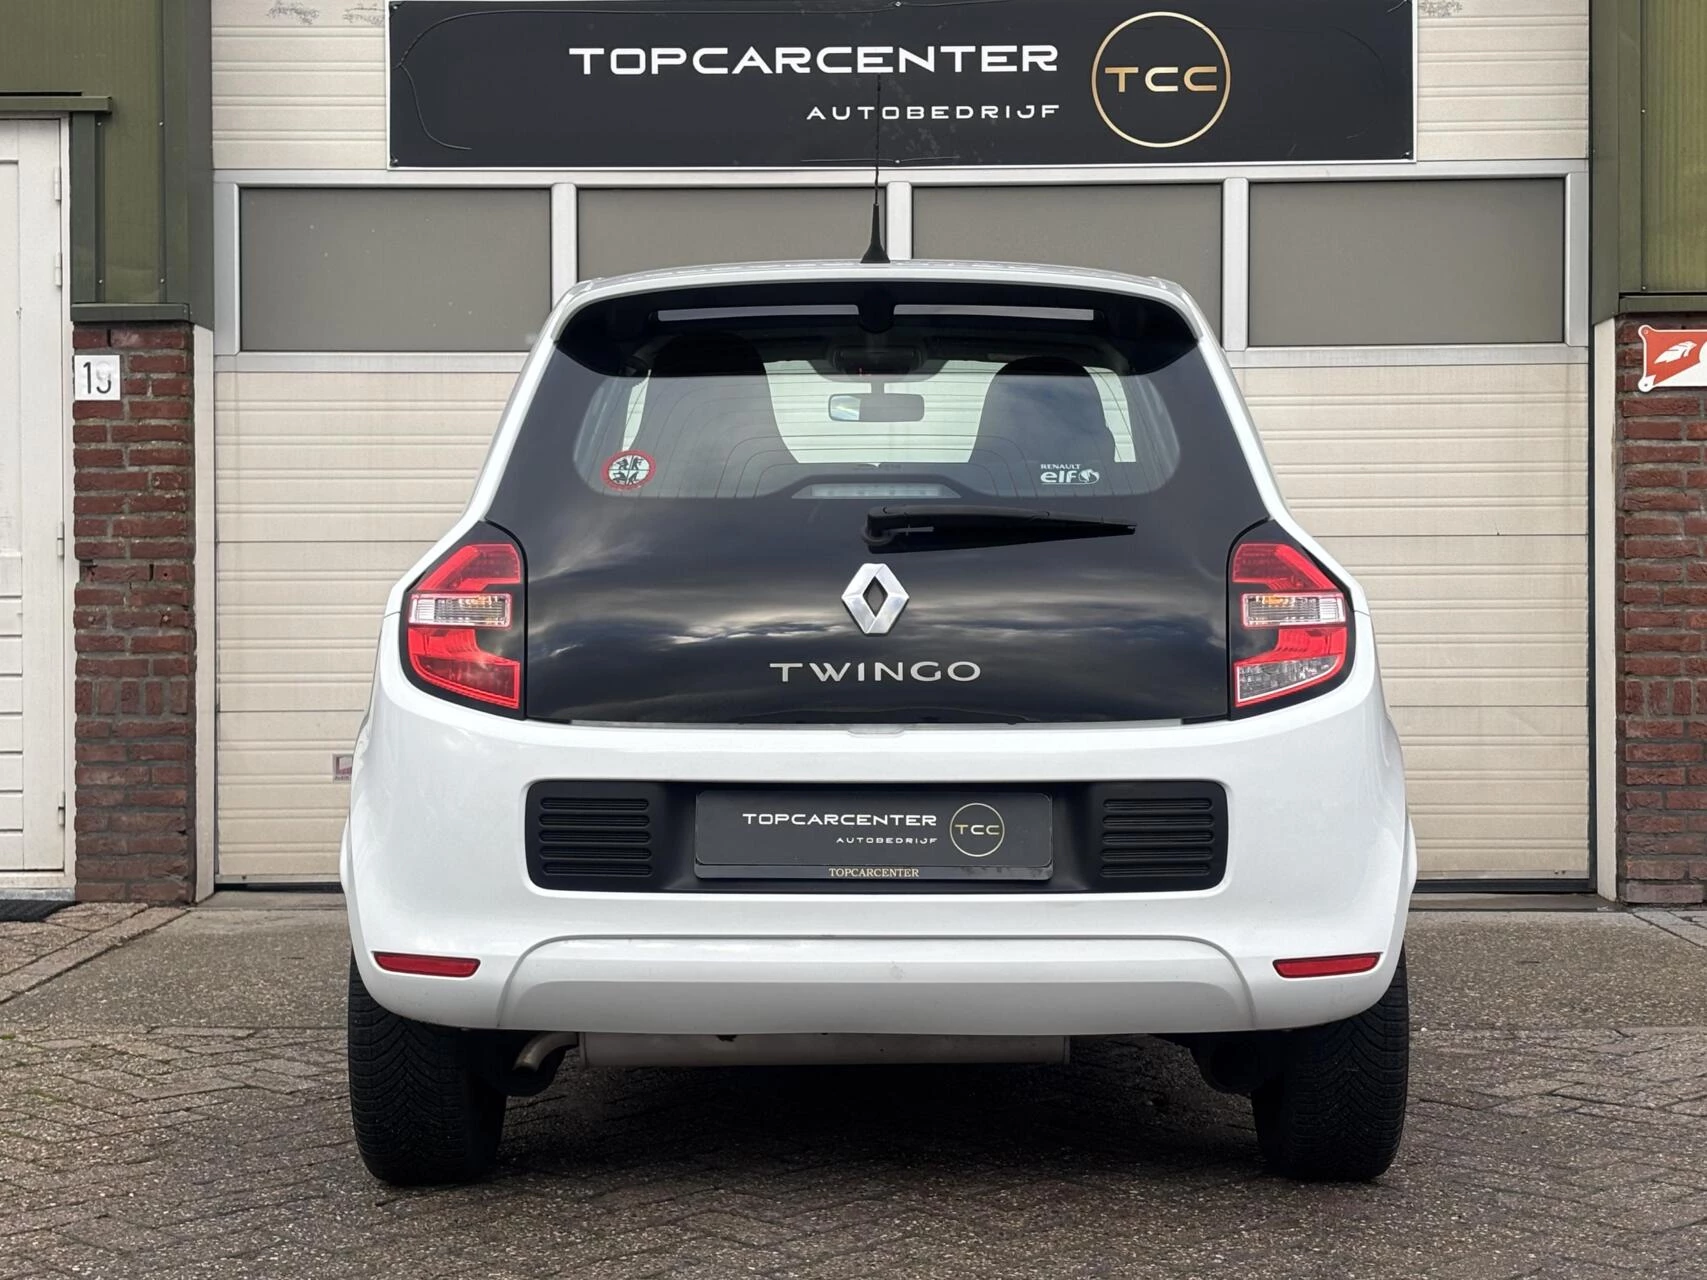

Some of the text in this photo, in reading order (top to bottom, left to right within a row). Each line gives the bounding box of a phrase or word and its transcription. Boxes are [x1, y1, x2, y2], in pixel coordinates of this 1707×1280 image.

[569, 44, 1058, 77] TOPCARCENTER
[1104, 66, 1219, 93] TCC
[806, 104, 1061, 121] AUTOBEDRIJF
[1040, 470, 1078, 484] elf
[769, 661, 982, 682] TWINGO
[742, 812, 938, 827] TOPCARCENTER
[954, 823, 1002, 836] TCC
[835, 837, 938, 845] AUTOBEDRIJF
[828, 867, 920, 878] TOPCARCENTER
